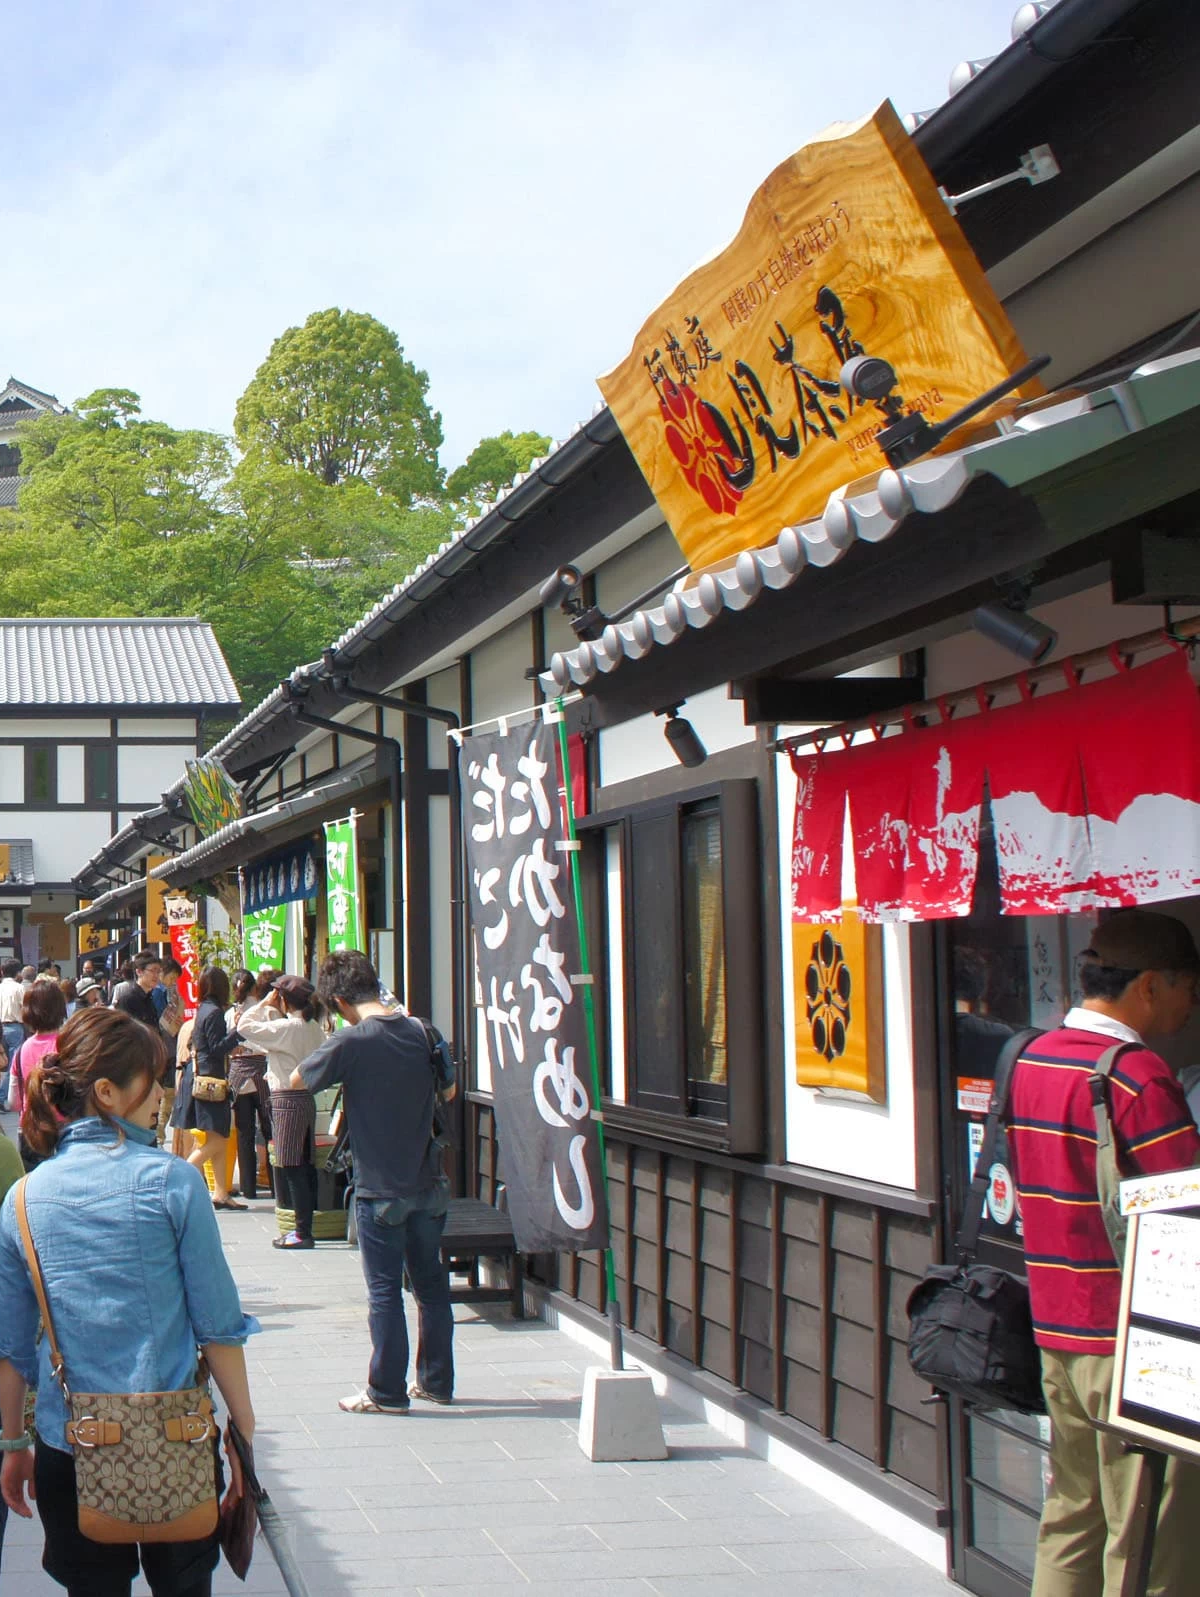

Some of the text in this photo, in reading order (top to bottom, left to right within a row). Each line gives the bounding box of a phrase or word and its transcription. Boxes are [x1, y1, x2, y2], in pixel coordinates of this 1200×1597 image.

[720, 201, 850, 331] 阿蘇の大自然を味わう
